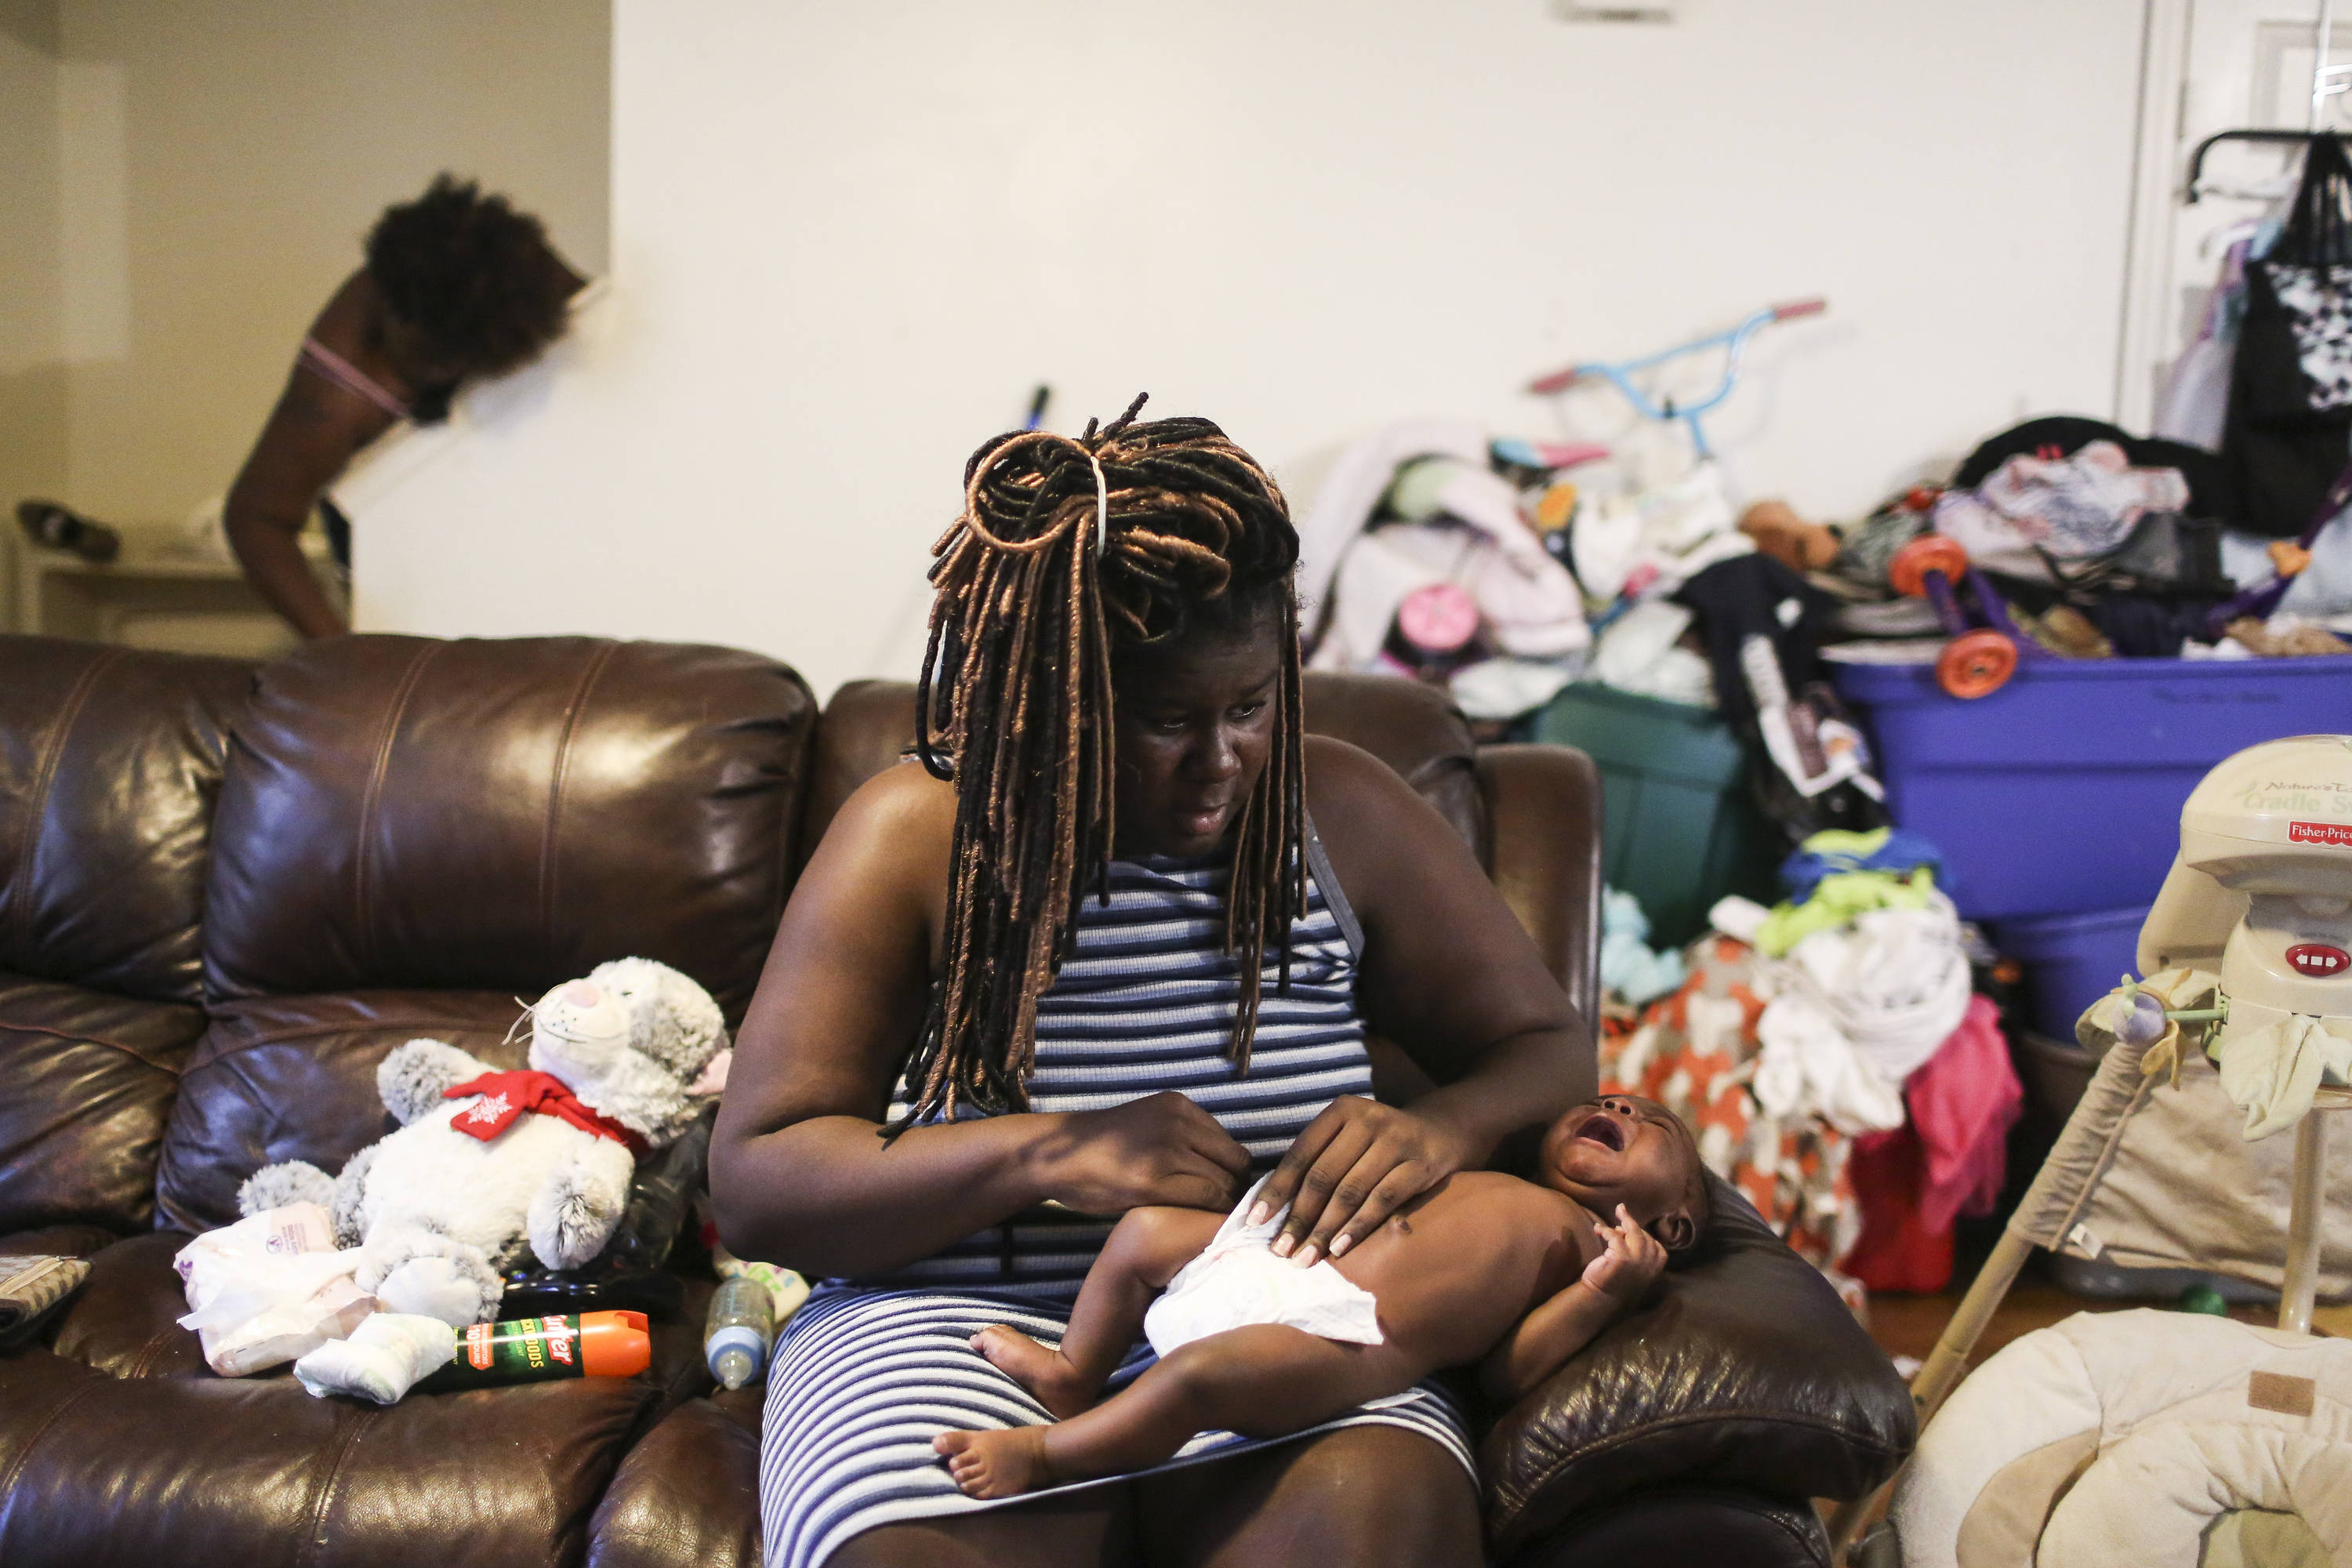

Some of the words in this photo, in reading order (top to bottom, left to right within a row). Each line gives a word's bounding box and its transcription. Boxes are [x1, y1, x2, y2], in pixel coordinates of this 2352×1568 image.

[2243, 792, 2321, 812] Cradle
[2332, 795, 2352, 814] S
[520, 1319, 545, 1368] CKOODS
